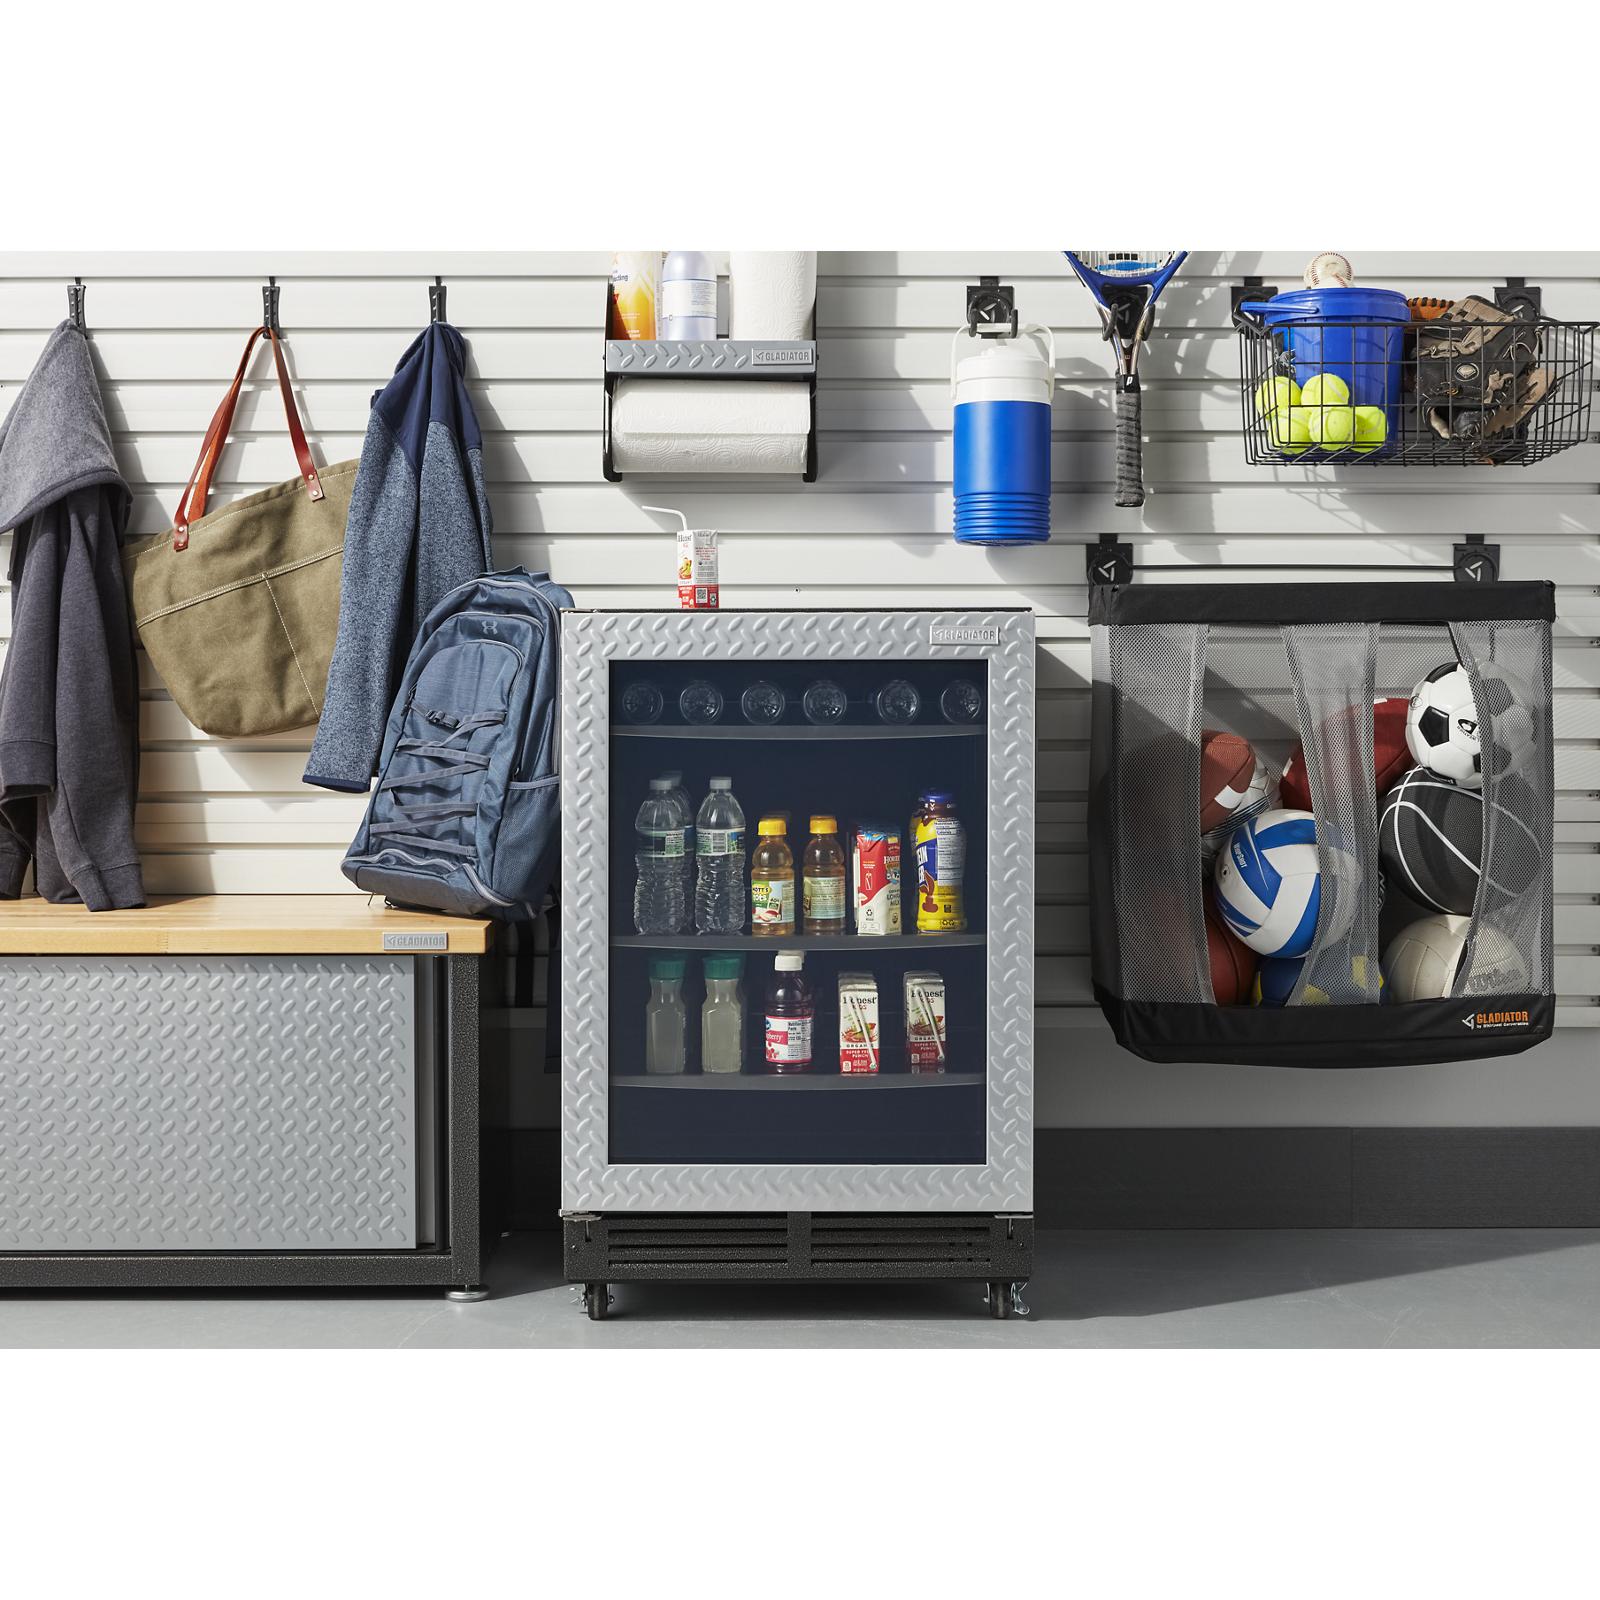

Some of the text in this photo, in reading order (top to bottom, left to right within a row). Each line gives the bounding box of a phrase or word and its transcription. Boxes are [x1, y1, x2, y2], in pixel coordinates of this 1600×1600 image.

[765, 351, 809, 361] GLADIATOR
[944, 629, 995, 641] GLADIATOR
[397, 935, 446, 946] GLADIATOR
[1476, 1011, 1529, 1024] GLADIATOR
